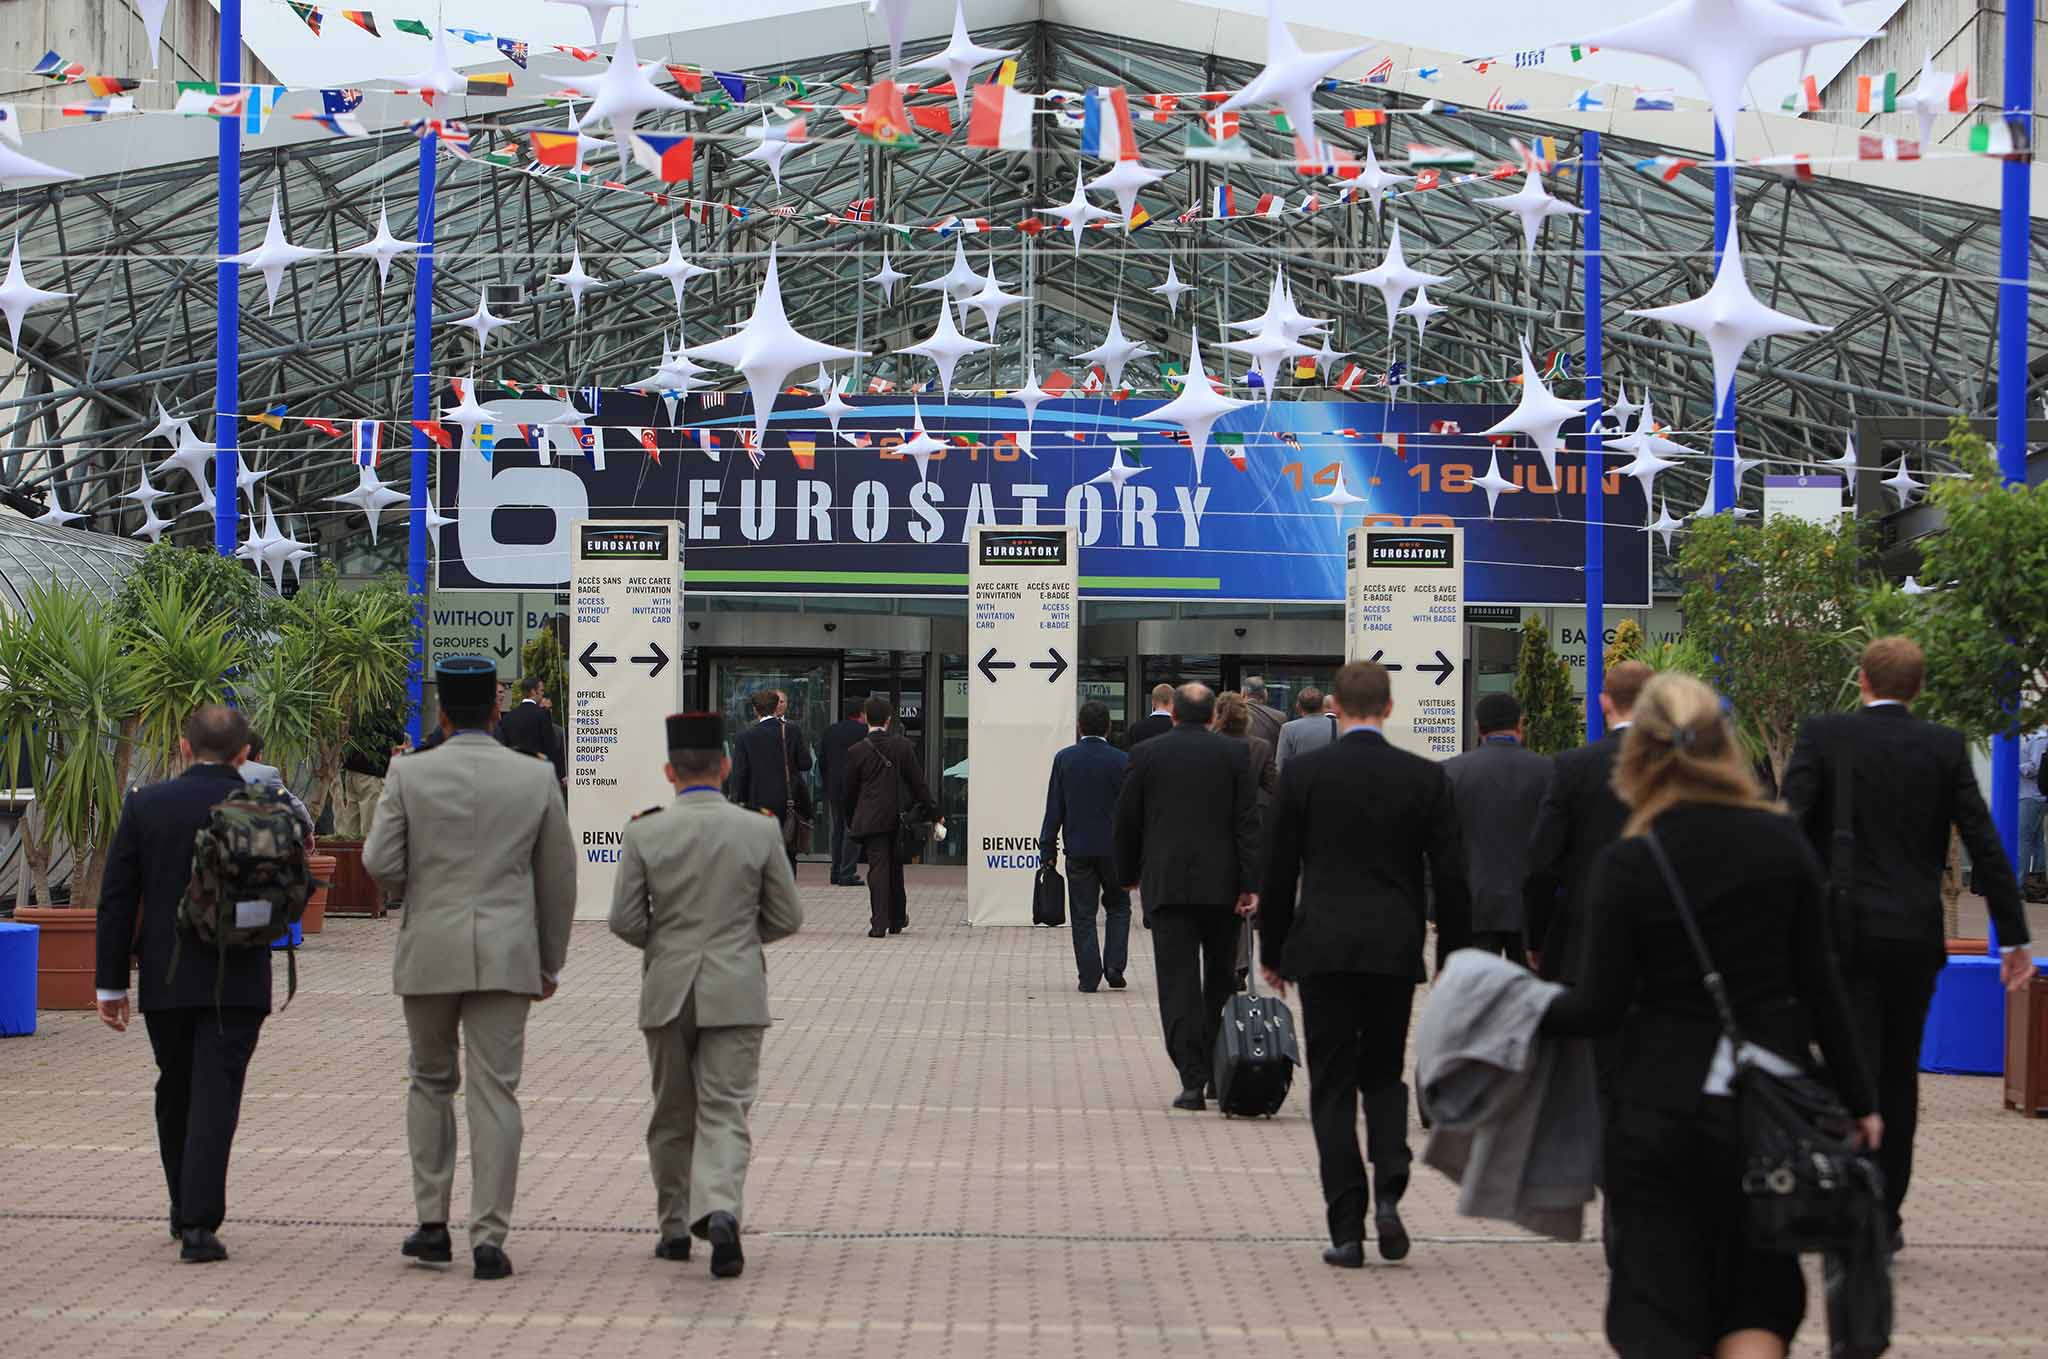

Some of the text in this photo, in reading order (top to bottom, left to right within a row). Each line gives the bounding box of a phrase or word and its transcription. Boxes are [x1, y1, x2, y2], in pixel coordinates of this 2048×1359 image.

[1281, 461, 1347, 493] 14
[1408, 463, 1474, 493] 18
[687, 479, 1212, 547] EUROSATORY
[587, 541, 660, 550] EUROSATORY
[986, 546, 1059, 556] EUROSATORY
[1373, 548, 1446, 558] EUROSATORY
[629, 577, 671, 585] AVEC CARTE
[1434, 594, 1457, 602] BADGE
[976, 603, 995, 611] WITH
[1042, 603, 1070, 611] ACCESS
[1363, 605, 1391, 613] ACCESS
[433, 610, 514, 626] WITHOUT
[976, 612, 1015, 620] INVITATION
[1051, 612, 1070, 620] WITH
[1363, 614, 1382, 622] WITH
[976, 621, 995, 629] CARD
[1040, 621, 1070, 629] E-BADGE
[433, 637, 489, 648] GROUPES
[576, 736, 618, 744] EXHIBITORS
[576, 768, 596, 776] EDSM
[593, 778, 617, 786] FORUM
